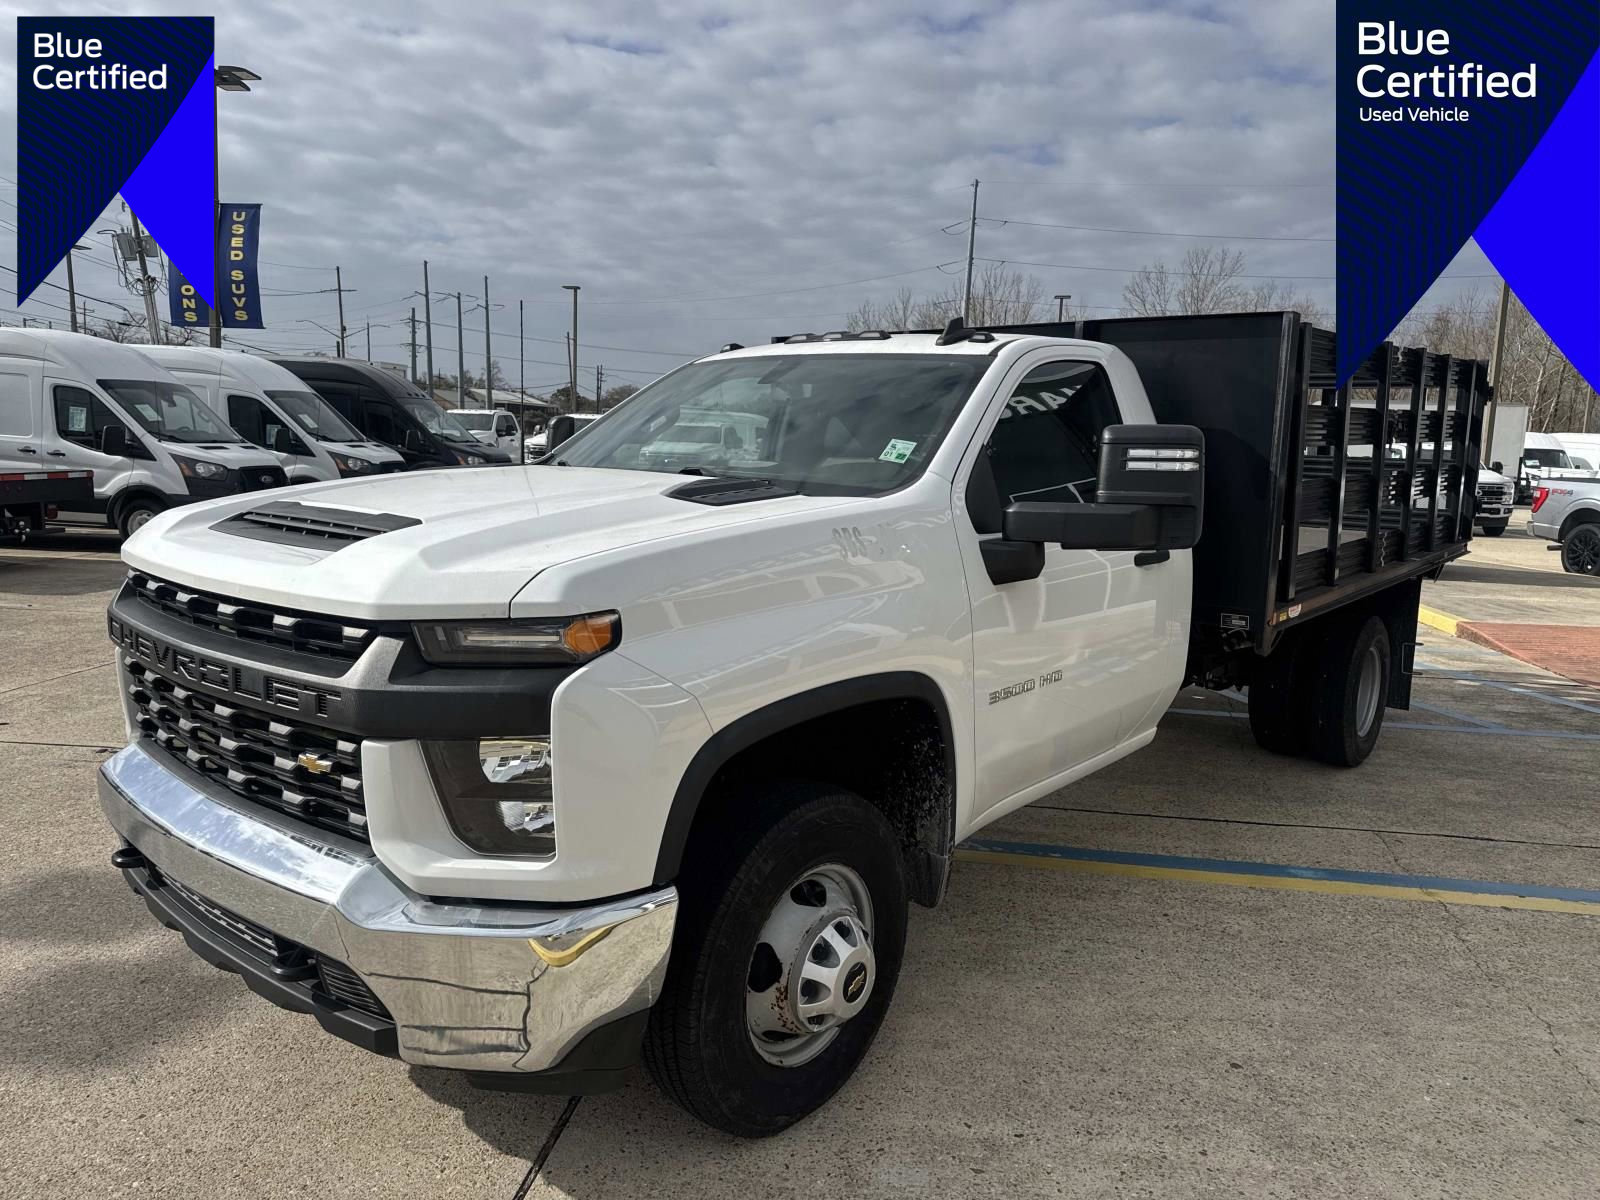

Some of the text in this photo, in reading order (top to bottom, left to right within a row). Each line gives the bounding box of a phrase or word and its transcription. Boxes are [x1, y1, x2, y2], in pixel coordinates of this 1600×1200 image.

[180, 272, 198, 322] ONS
[230, 211, 248, 321] USED SUVS
[110, 618, 343, 718] CHEVROLET
[988, 669, 1064, 706] 3500 HD
